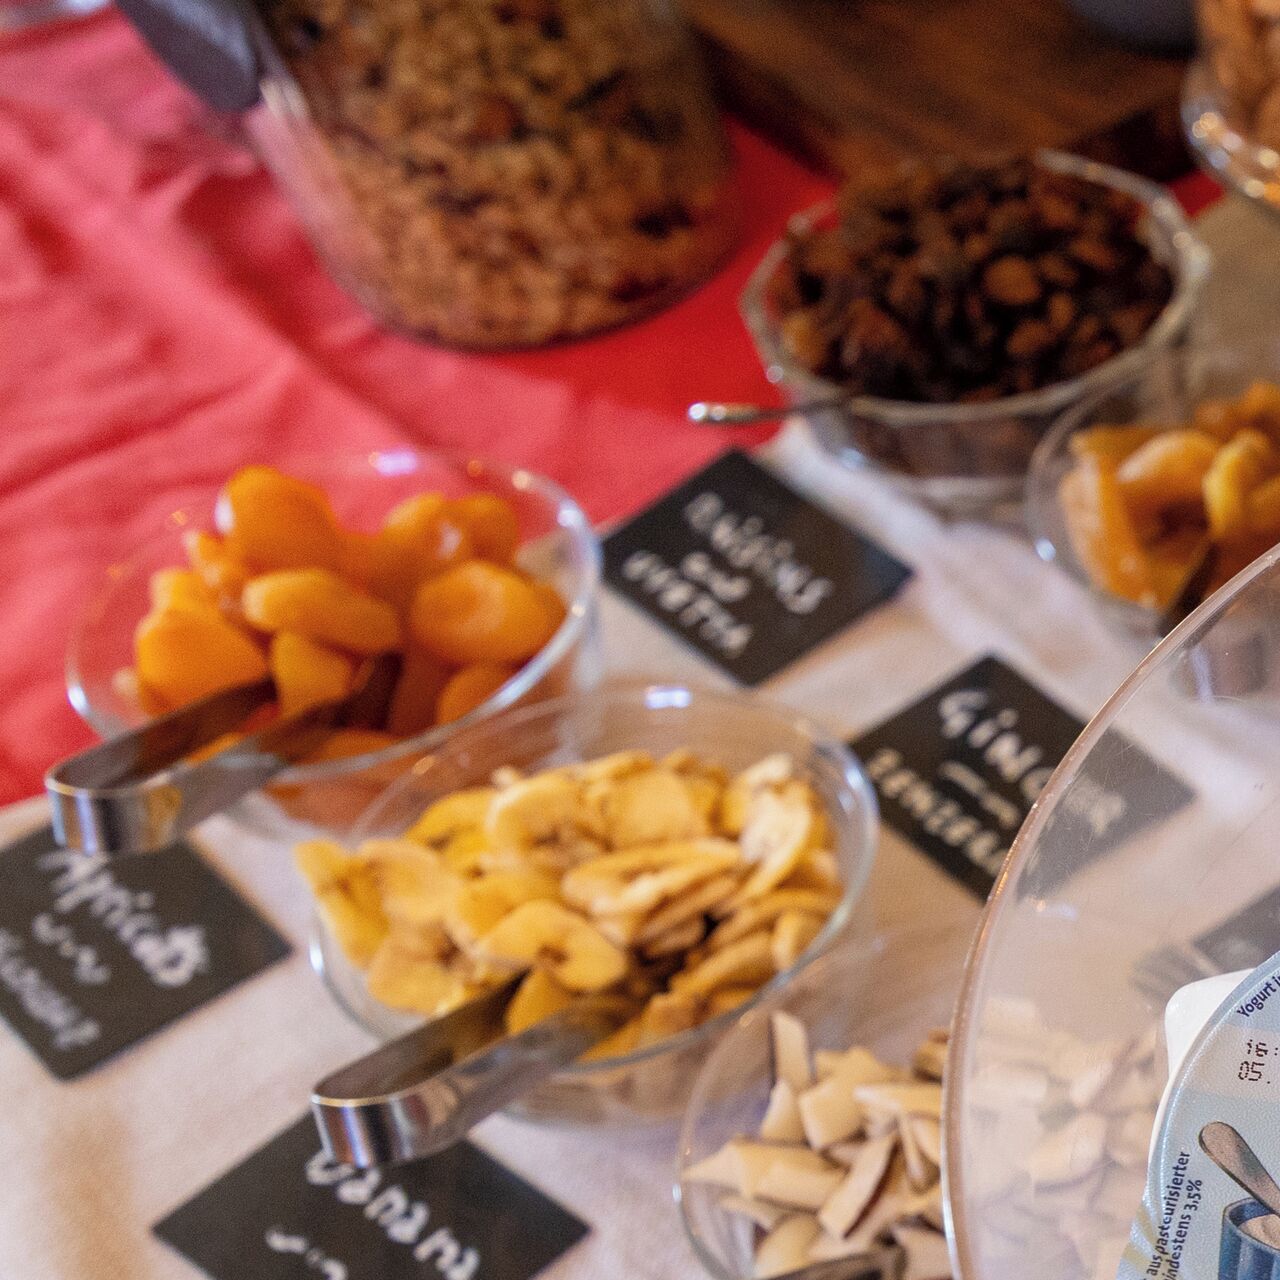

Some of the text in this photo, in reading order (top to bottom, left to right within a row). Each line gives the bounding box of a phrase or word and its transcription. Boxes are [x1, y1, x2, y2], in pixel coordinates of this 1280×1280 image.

[1236, 982, 1278, 1019] Yogurt
[1146, 1254, 1162, 1276] aus
[1155, 1151, 1191, 1257] pasteurisierter
[1185, 1180, 1203, 1212] 3,5%
